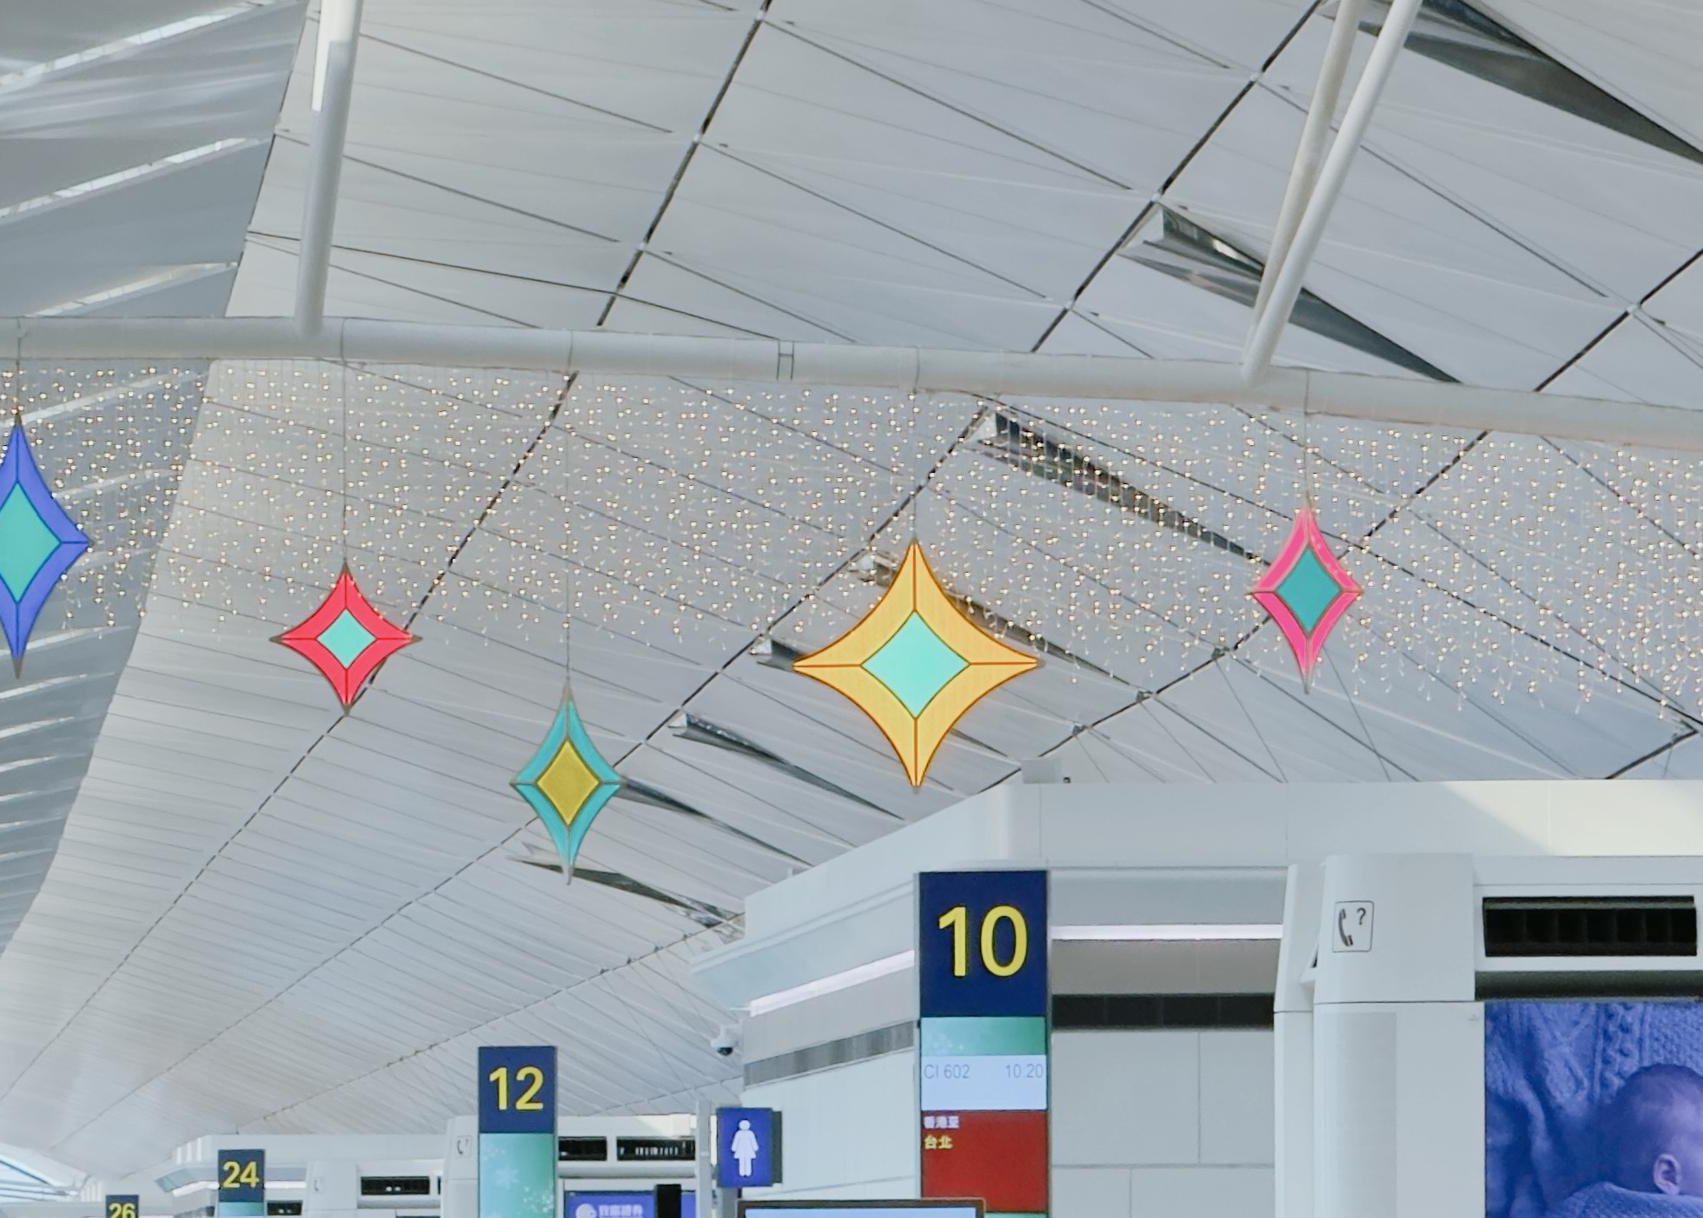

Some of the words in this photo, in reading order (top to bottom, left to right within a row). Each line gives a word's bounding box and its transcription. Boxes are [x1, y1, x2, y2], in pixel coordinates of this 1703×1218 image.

[937, 905, 1029, 978] 10
[488, 1066, 544, 1111] 12
[924, 1064, 939, 1080] CI
[943, 1064, 971, 1080] 602
[222, 1160, 259, 1190] 24
